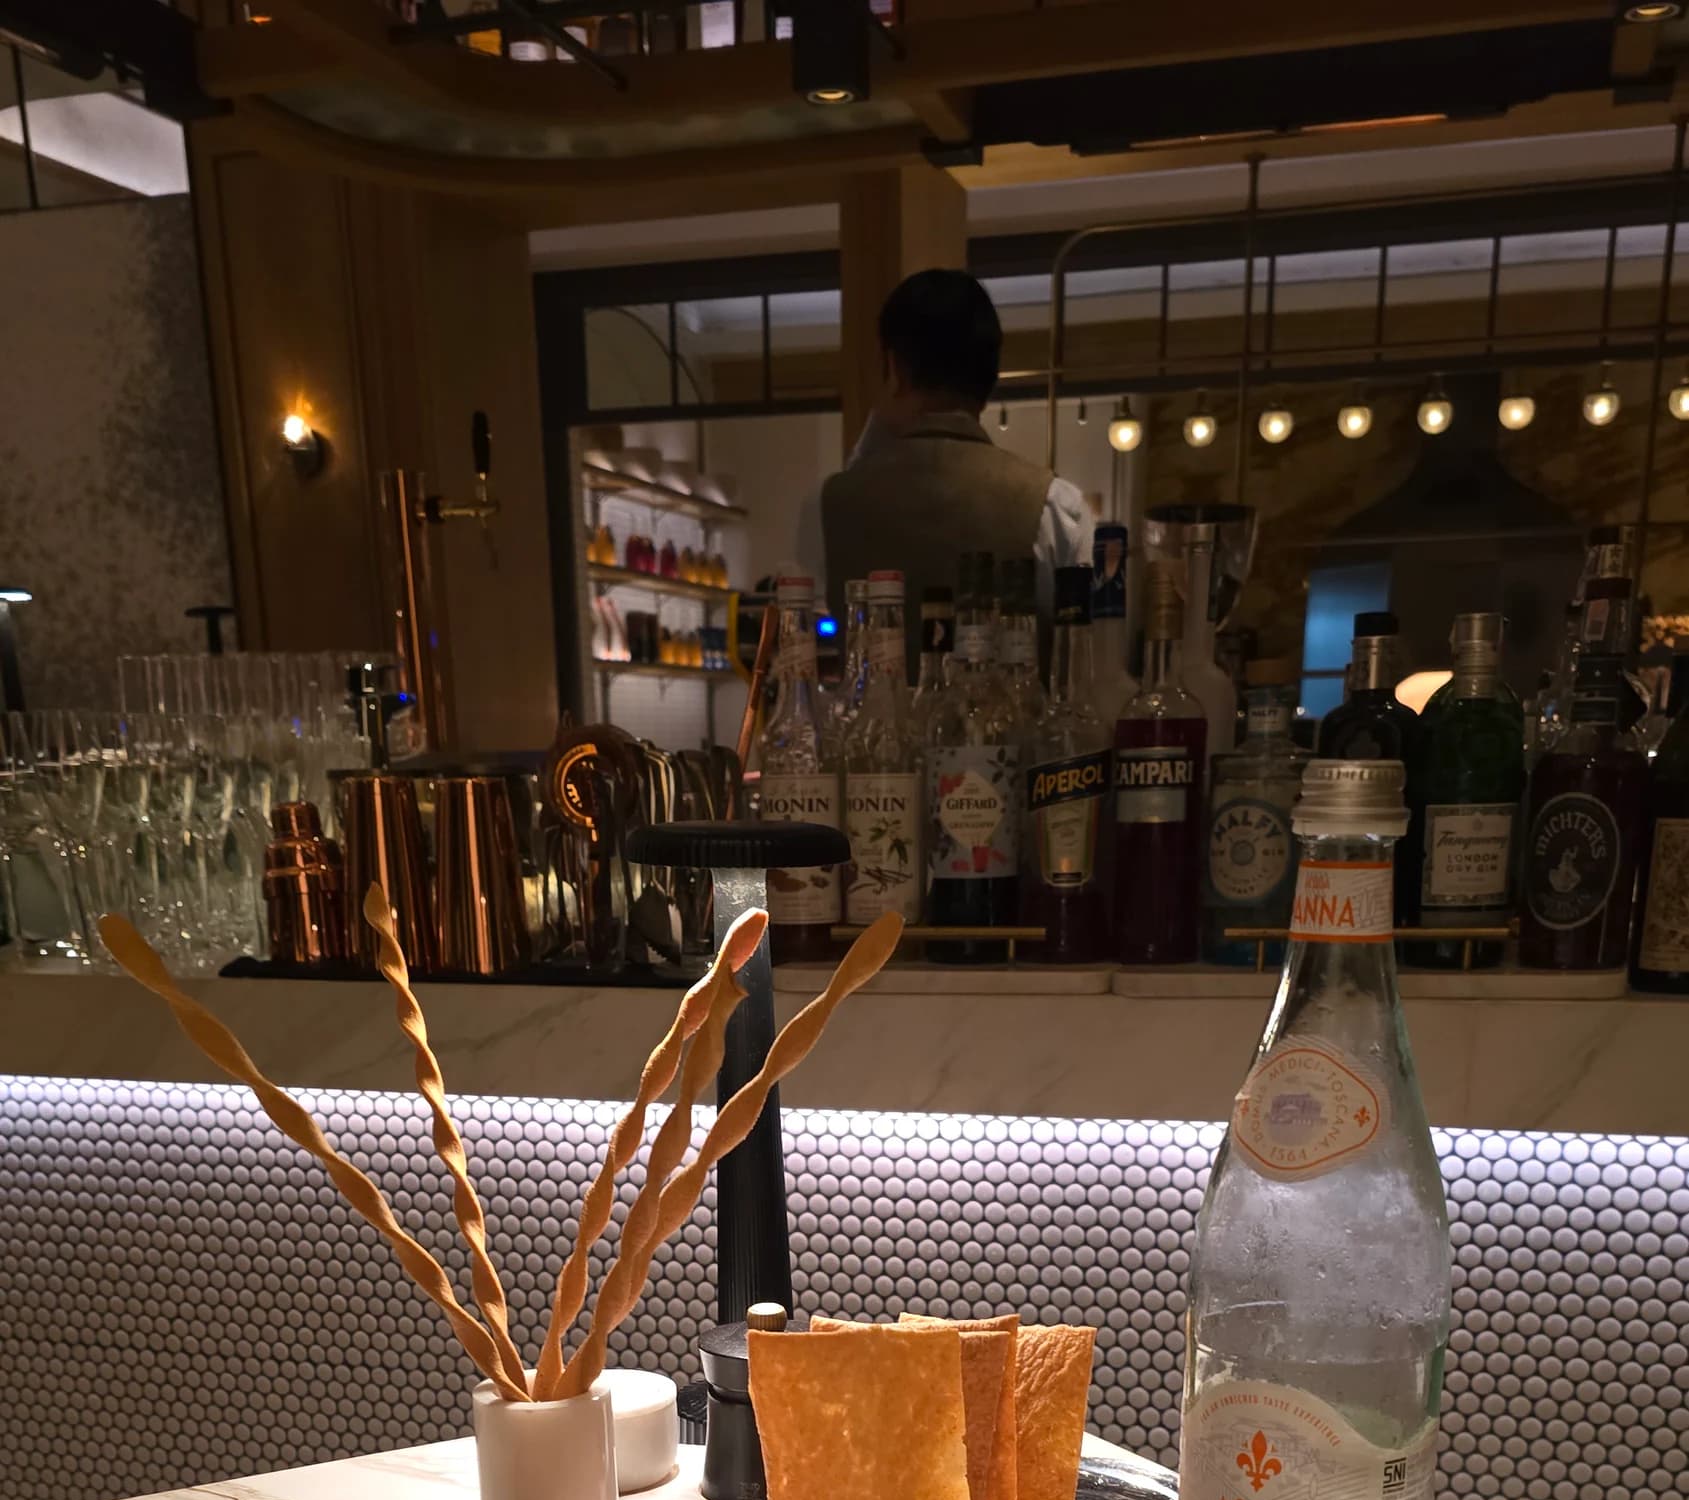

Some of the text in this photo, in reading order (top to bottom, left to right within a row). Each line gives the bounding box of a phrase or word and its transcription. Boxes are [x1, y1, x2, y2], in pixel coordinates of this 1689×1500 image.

[1033, 761, 1105, 803] APEROL
[946, 799, 997, 810] GIFFARD
[1447, 854, 1498, 863] LONDON
[1476, 864, 1497, 873] GIN
[1294, 896, 1355, 928] ANNA
[1263, 1396, 1290, 1412] TASTE
[1383, 1463, 1406, 1483] SNI
